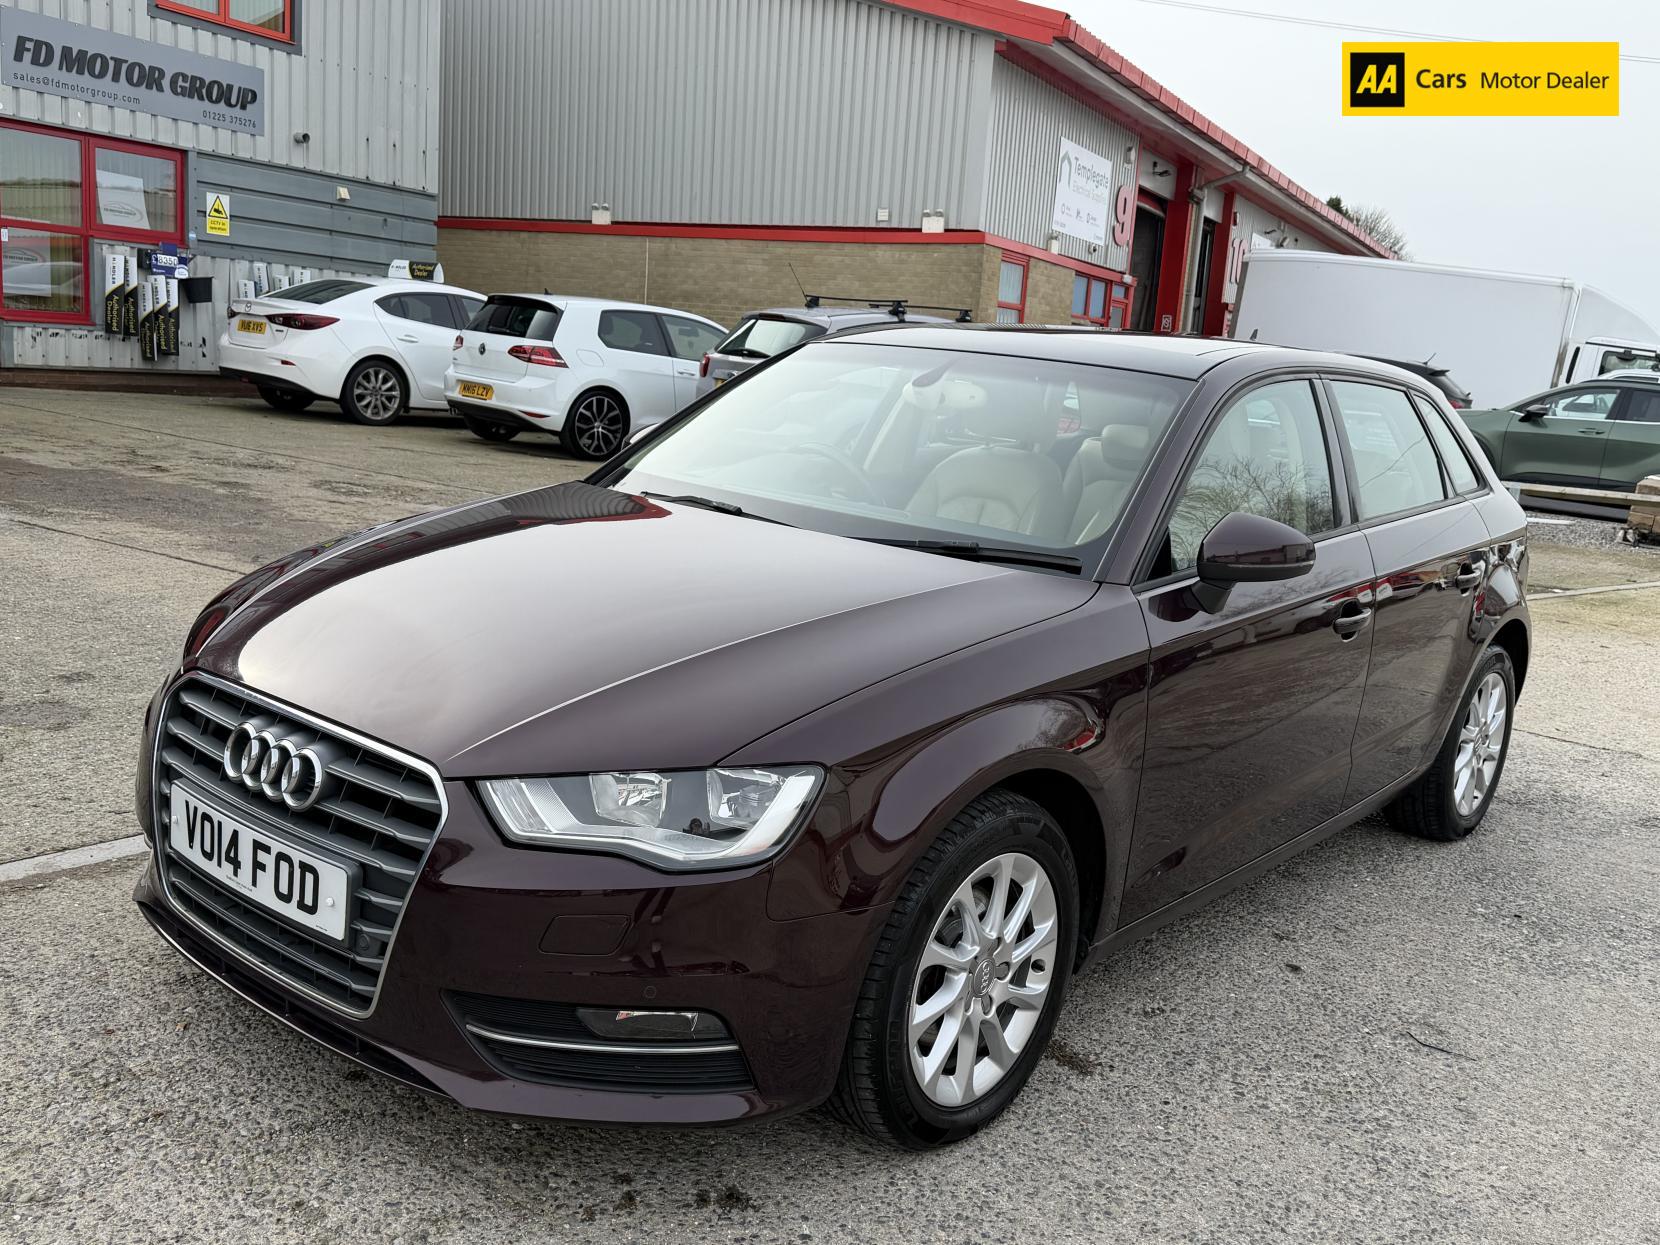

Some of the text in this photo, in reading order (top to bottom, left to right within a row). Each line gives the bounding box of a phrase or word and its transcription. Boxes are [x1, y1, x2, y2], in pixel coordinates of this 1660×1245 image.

[13, 34, 258, 111] FD MOTOR GROUP
[13, 72, 141, 105] sales@fdmotorgroup.com
[202, 109, 257, 129] 01225 375276
[1113, 185, 1133, 247] 9
[251, 838, 321, 916] FOD
